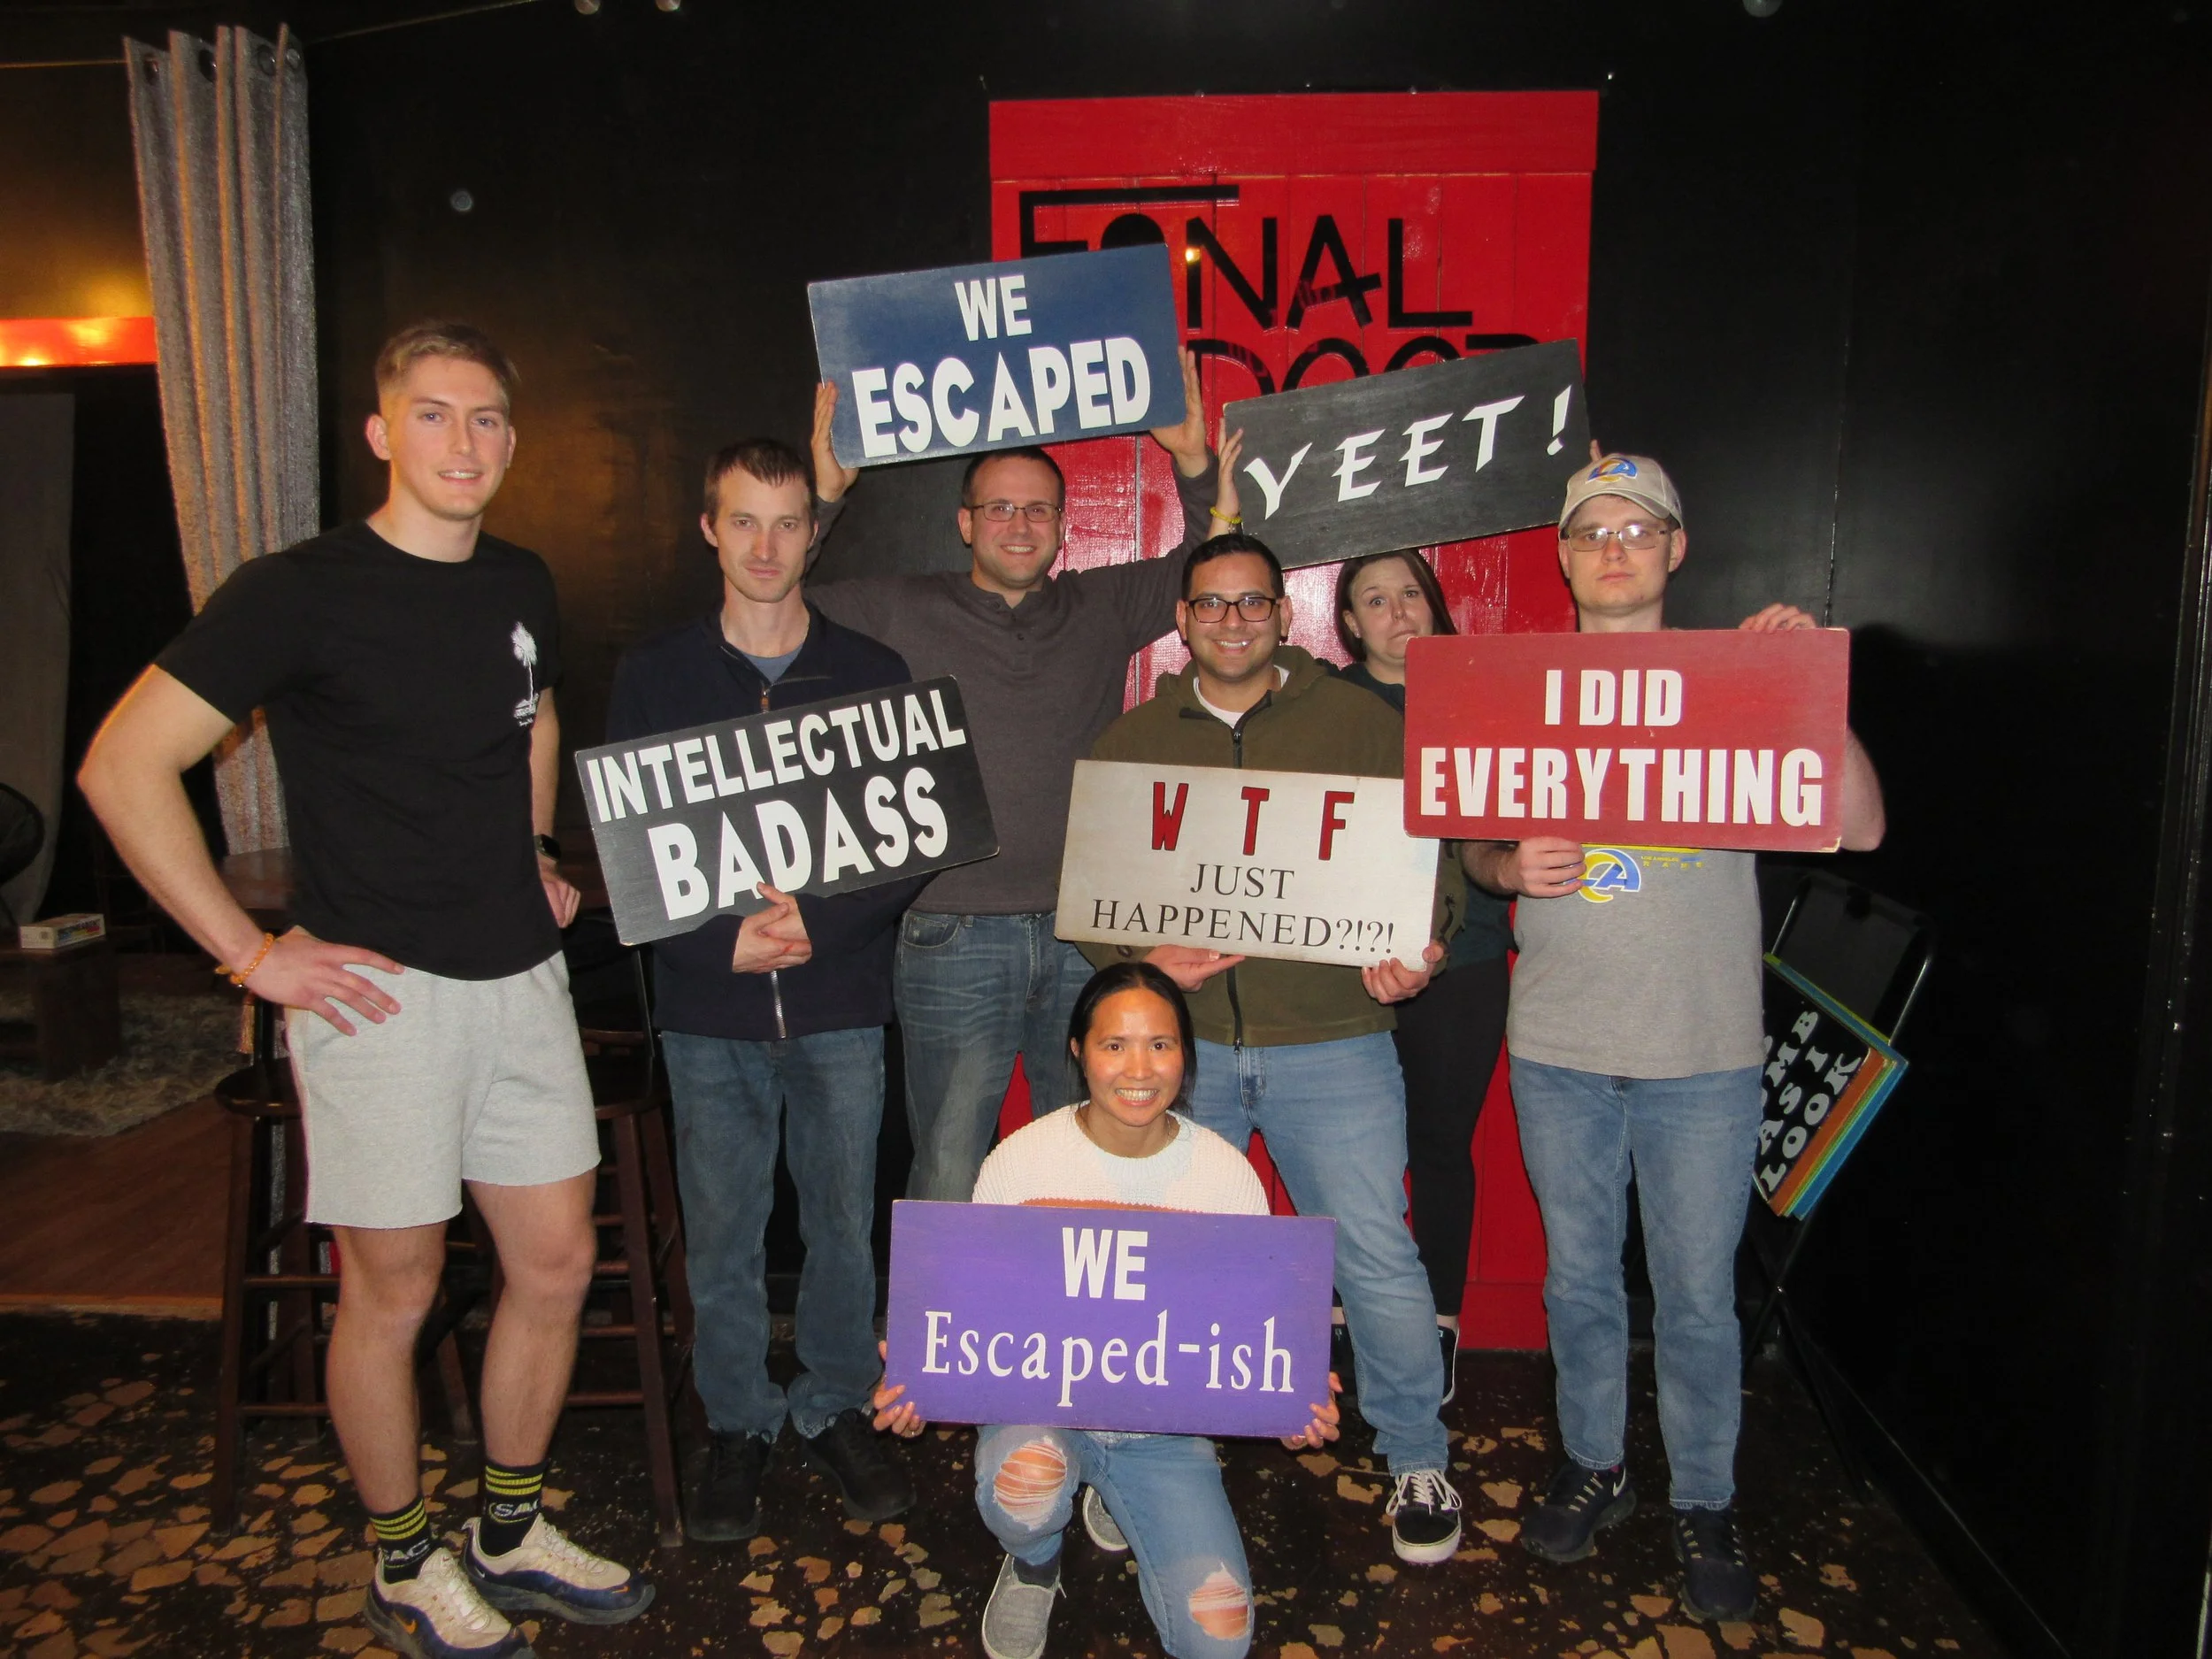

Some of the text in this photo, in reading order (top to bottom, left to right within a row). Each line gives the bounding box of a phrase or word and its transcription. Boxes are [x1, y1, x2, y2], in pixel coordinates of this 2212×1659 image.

[954, 274, 1033, 342] WE
[851, 336, 1151, 458] ESCAPED
[1545, 669, 1683, 726] I DID
[586, 689, 967, 823] INTELLECTUAL
[1420, 747, 1823, 827] EVERYTHING
[647, 767, 949, 921] BADASS
[1190, 864, 1294, 899] JUST
[1090, 899, 1395, 955] HAPPENED?!?!
[1760, 1053, 1862, 1193] LOOK
[1062, 1226, 1148, 1302] WE
[921, 1309, 1294, 1408] Escaped-ish
